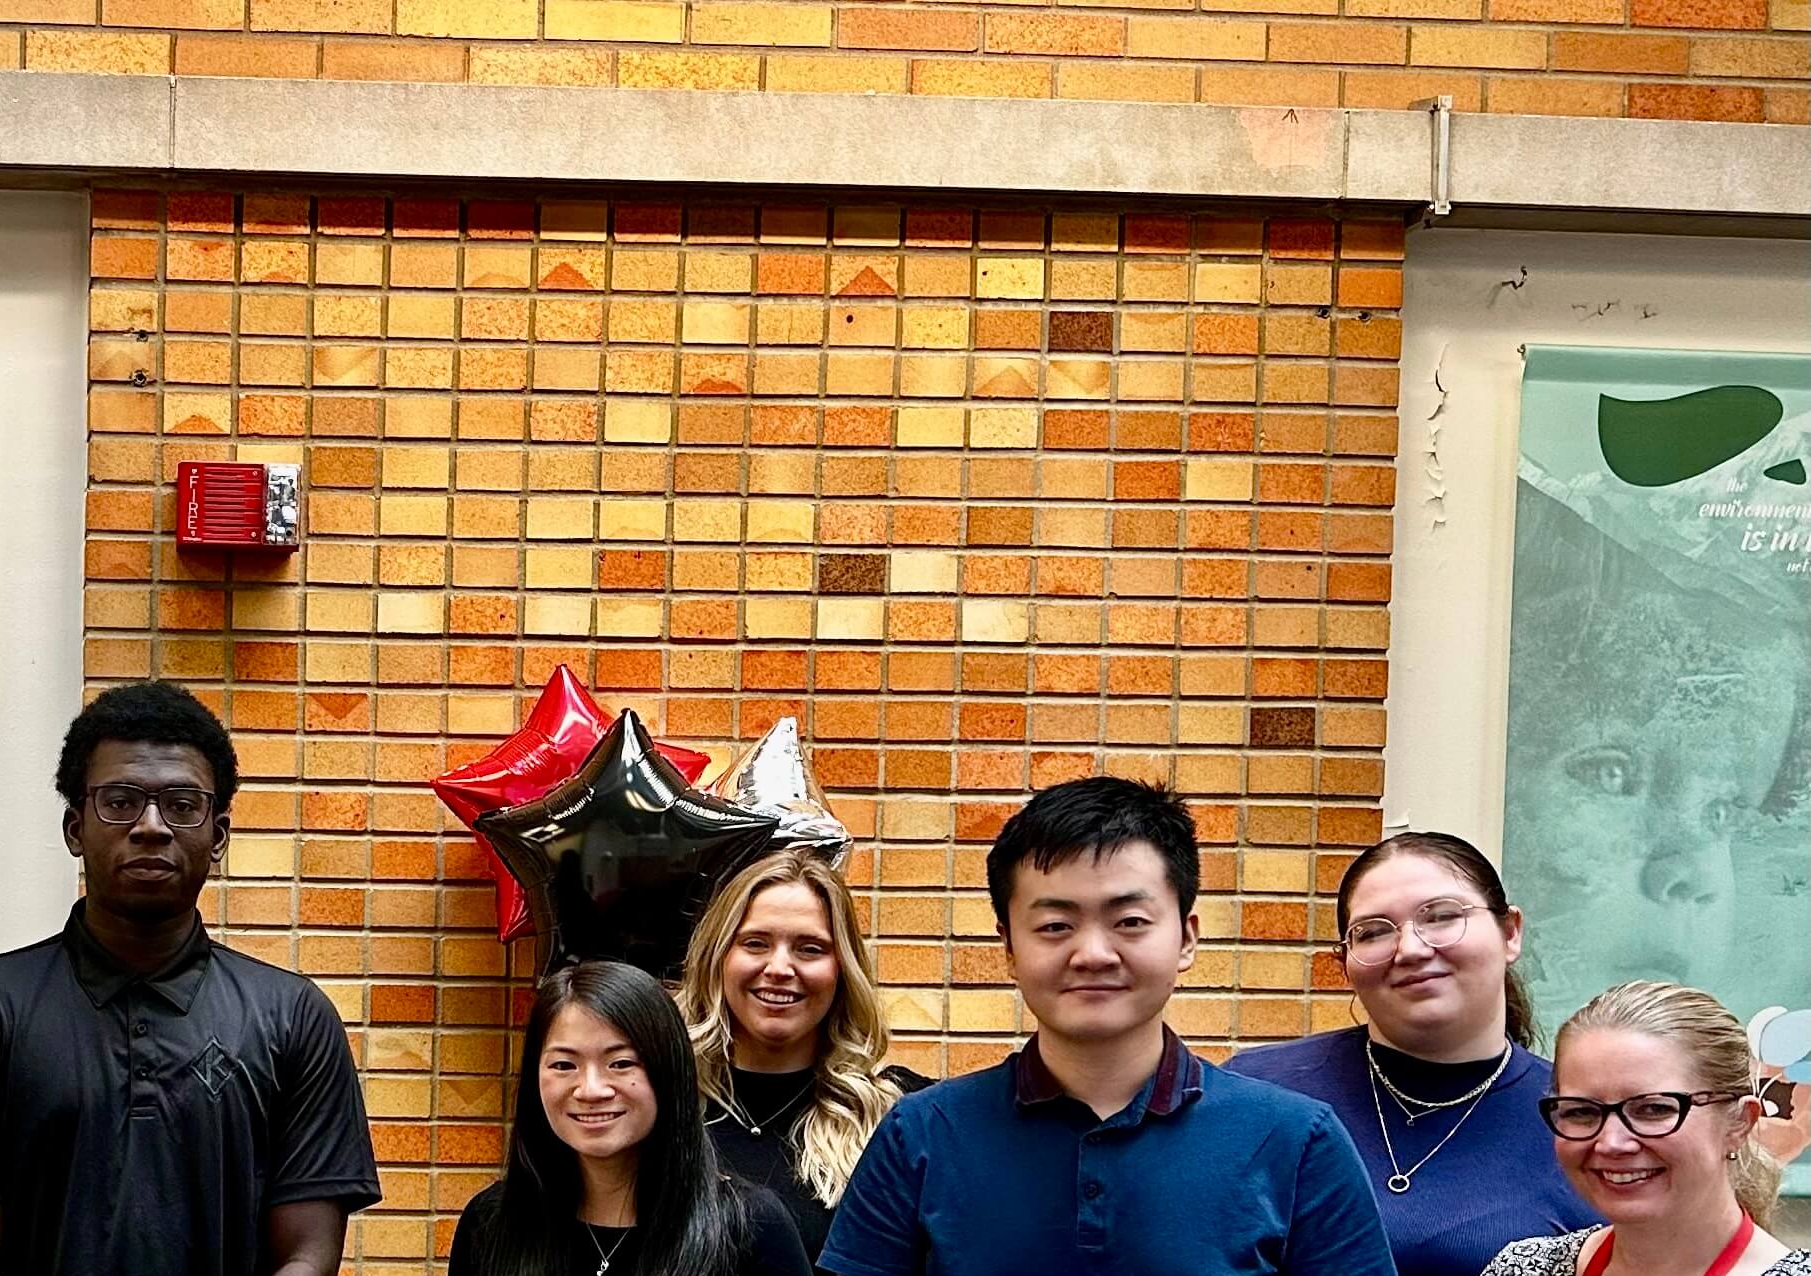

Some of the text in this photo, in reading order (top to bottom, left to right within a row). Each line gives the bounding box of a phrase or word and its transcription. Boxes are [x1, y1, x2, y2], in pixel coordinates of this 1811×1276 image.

[188, 475, 199, 530] FIRE
[1740, 522, 1767, 552] is
[1770, 524, 1799, 552] in
